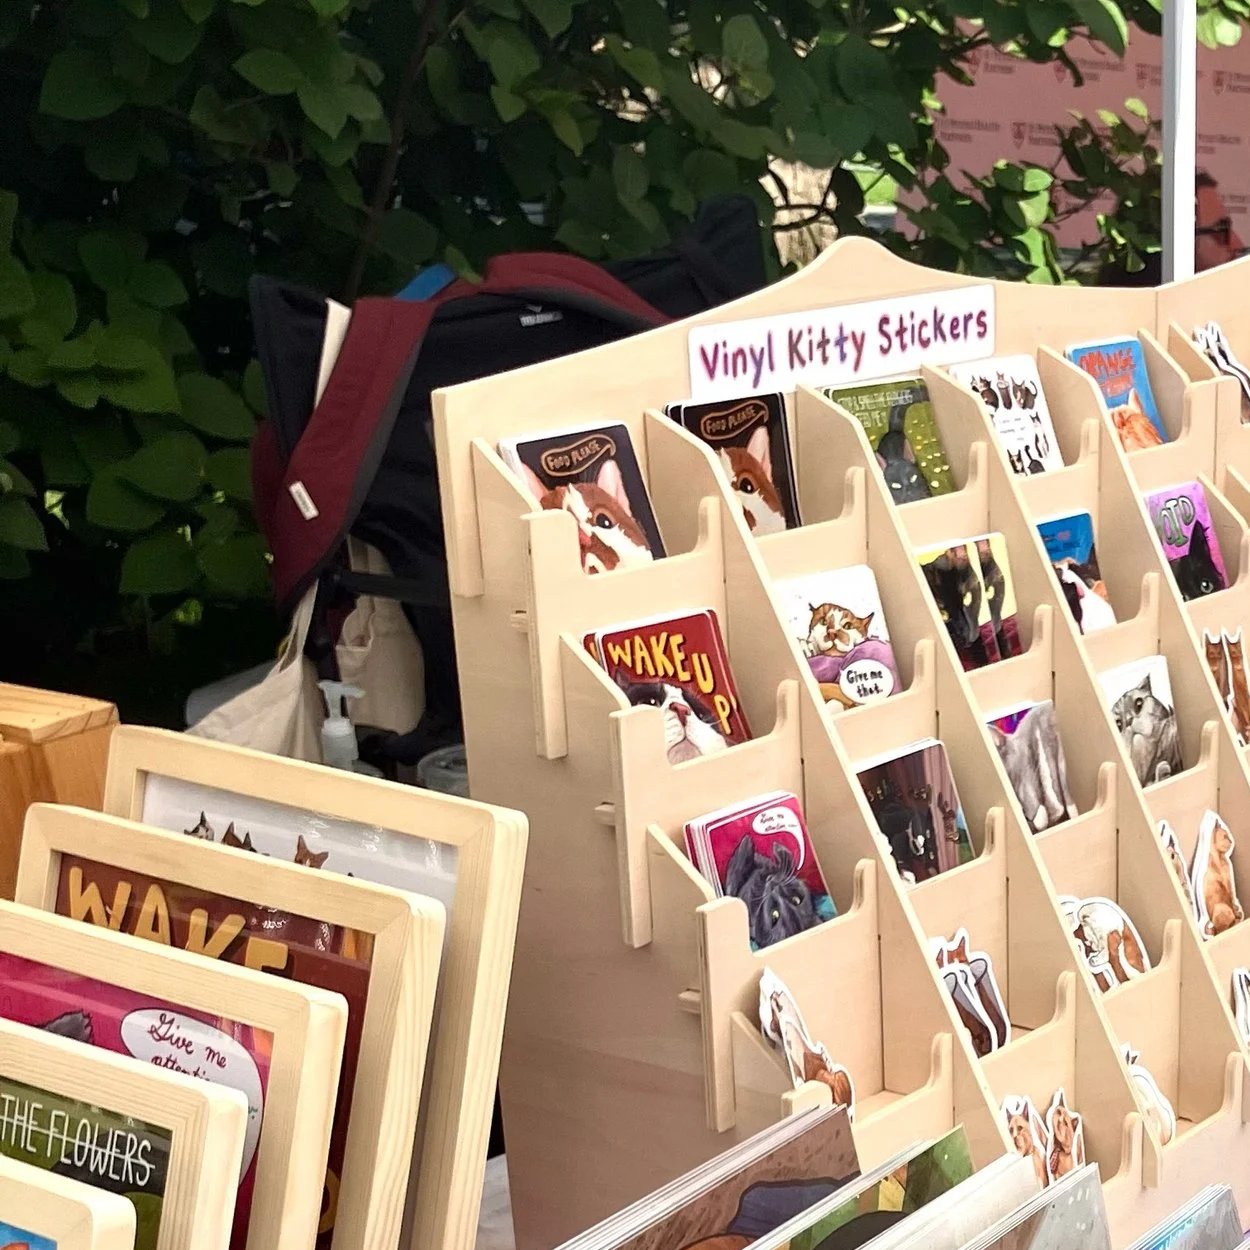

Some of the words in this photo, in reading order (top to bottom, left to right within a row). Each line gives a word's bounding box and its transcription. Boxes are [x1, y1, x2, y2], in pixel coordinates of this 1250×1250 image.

[700, 330, 775, 389] Vinyl
[787, 321, 866, 372] Kitty
[878, 306, 987, 355] Stickers
[727, 405, 759, 430] PLEASE
[570, 439, 602, 467] PLEASE
[1156, 495, 1195, 548] OID
[607, 632, 691, 682] WAKE
[846, 669, 868, 684] Give
[870, 670, 883, 679] me
[147, 1013, 194, 1055] Give
[206, 1046, 227, 1068] me
[1, 1094, 42, 1153] THE
[47, 1110, 154, 1186] FLOWERS
